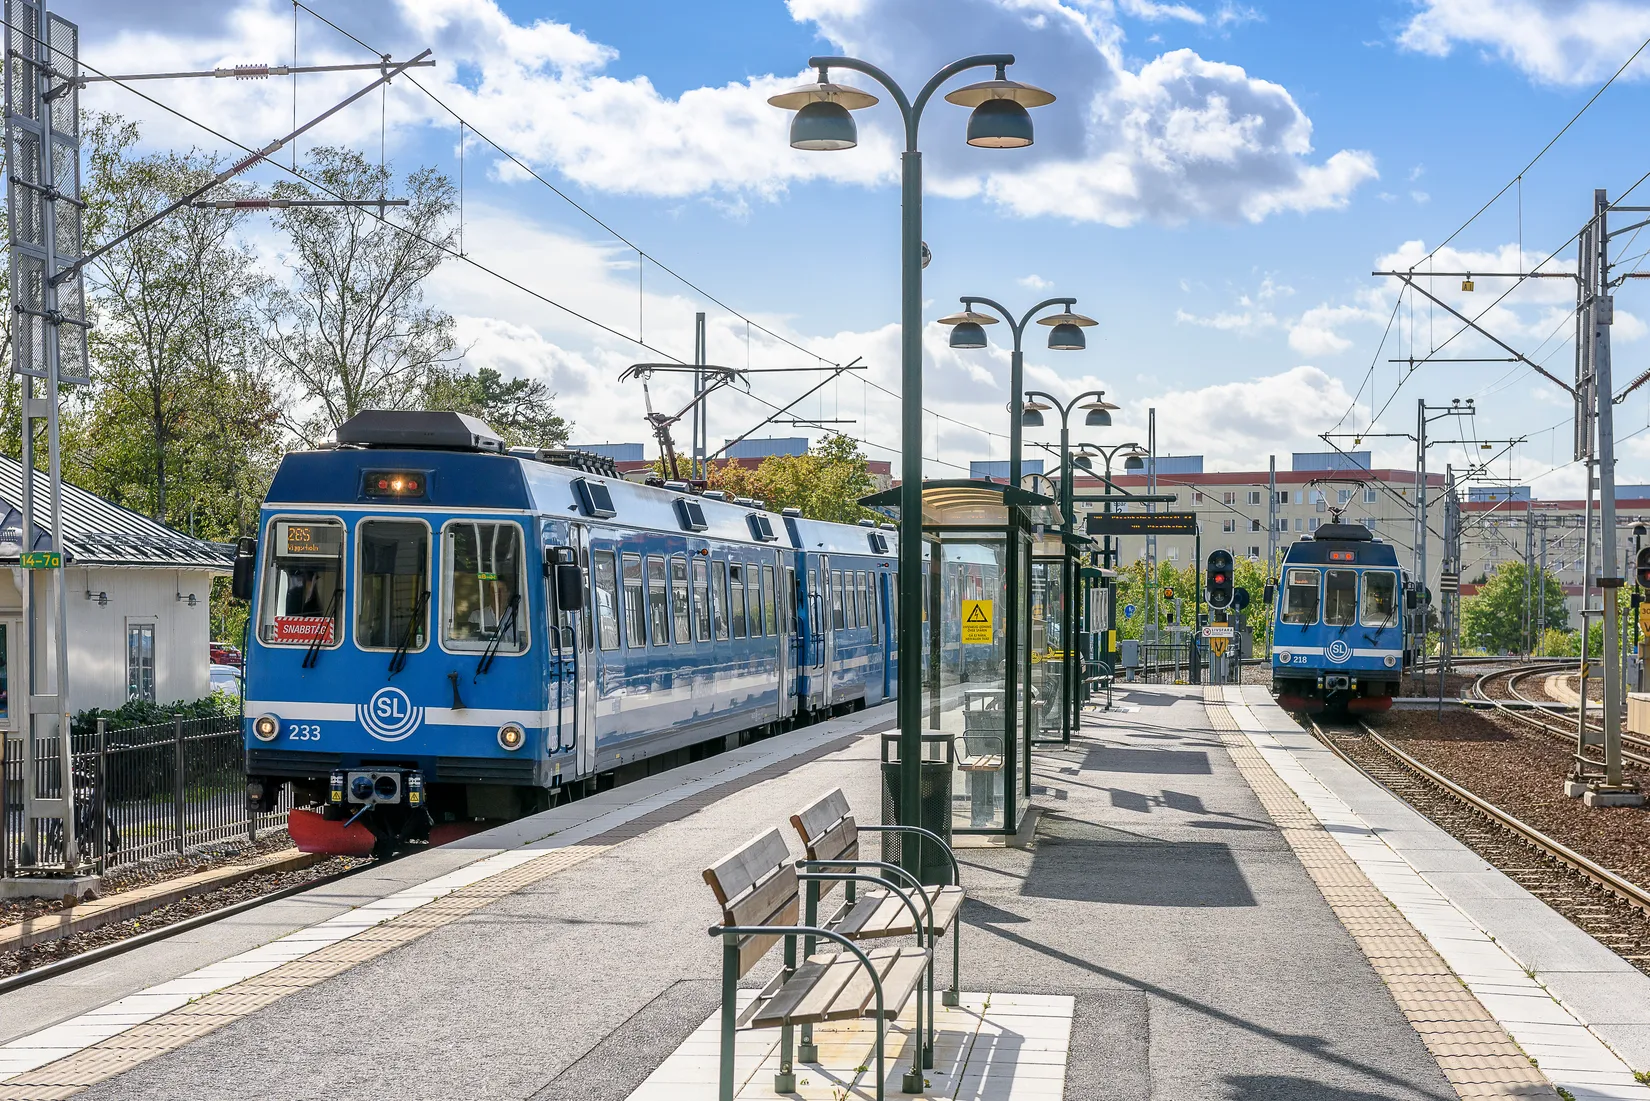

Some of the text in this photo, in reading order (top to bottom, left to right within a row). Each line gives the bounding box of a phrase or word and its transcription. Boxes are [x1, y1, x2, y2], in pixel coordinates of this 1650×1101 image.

[22, 555, 59, 566] 14-7a
[282, 623, 327, 635] SNABBTÅG
[1332, 644, 1344, 654] SL
[1293, 655, 1308, 664] 218
[376, 697, 405, 718] SL
[289, 724, 321, 741] 233
